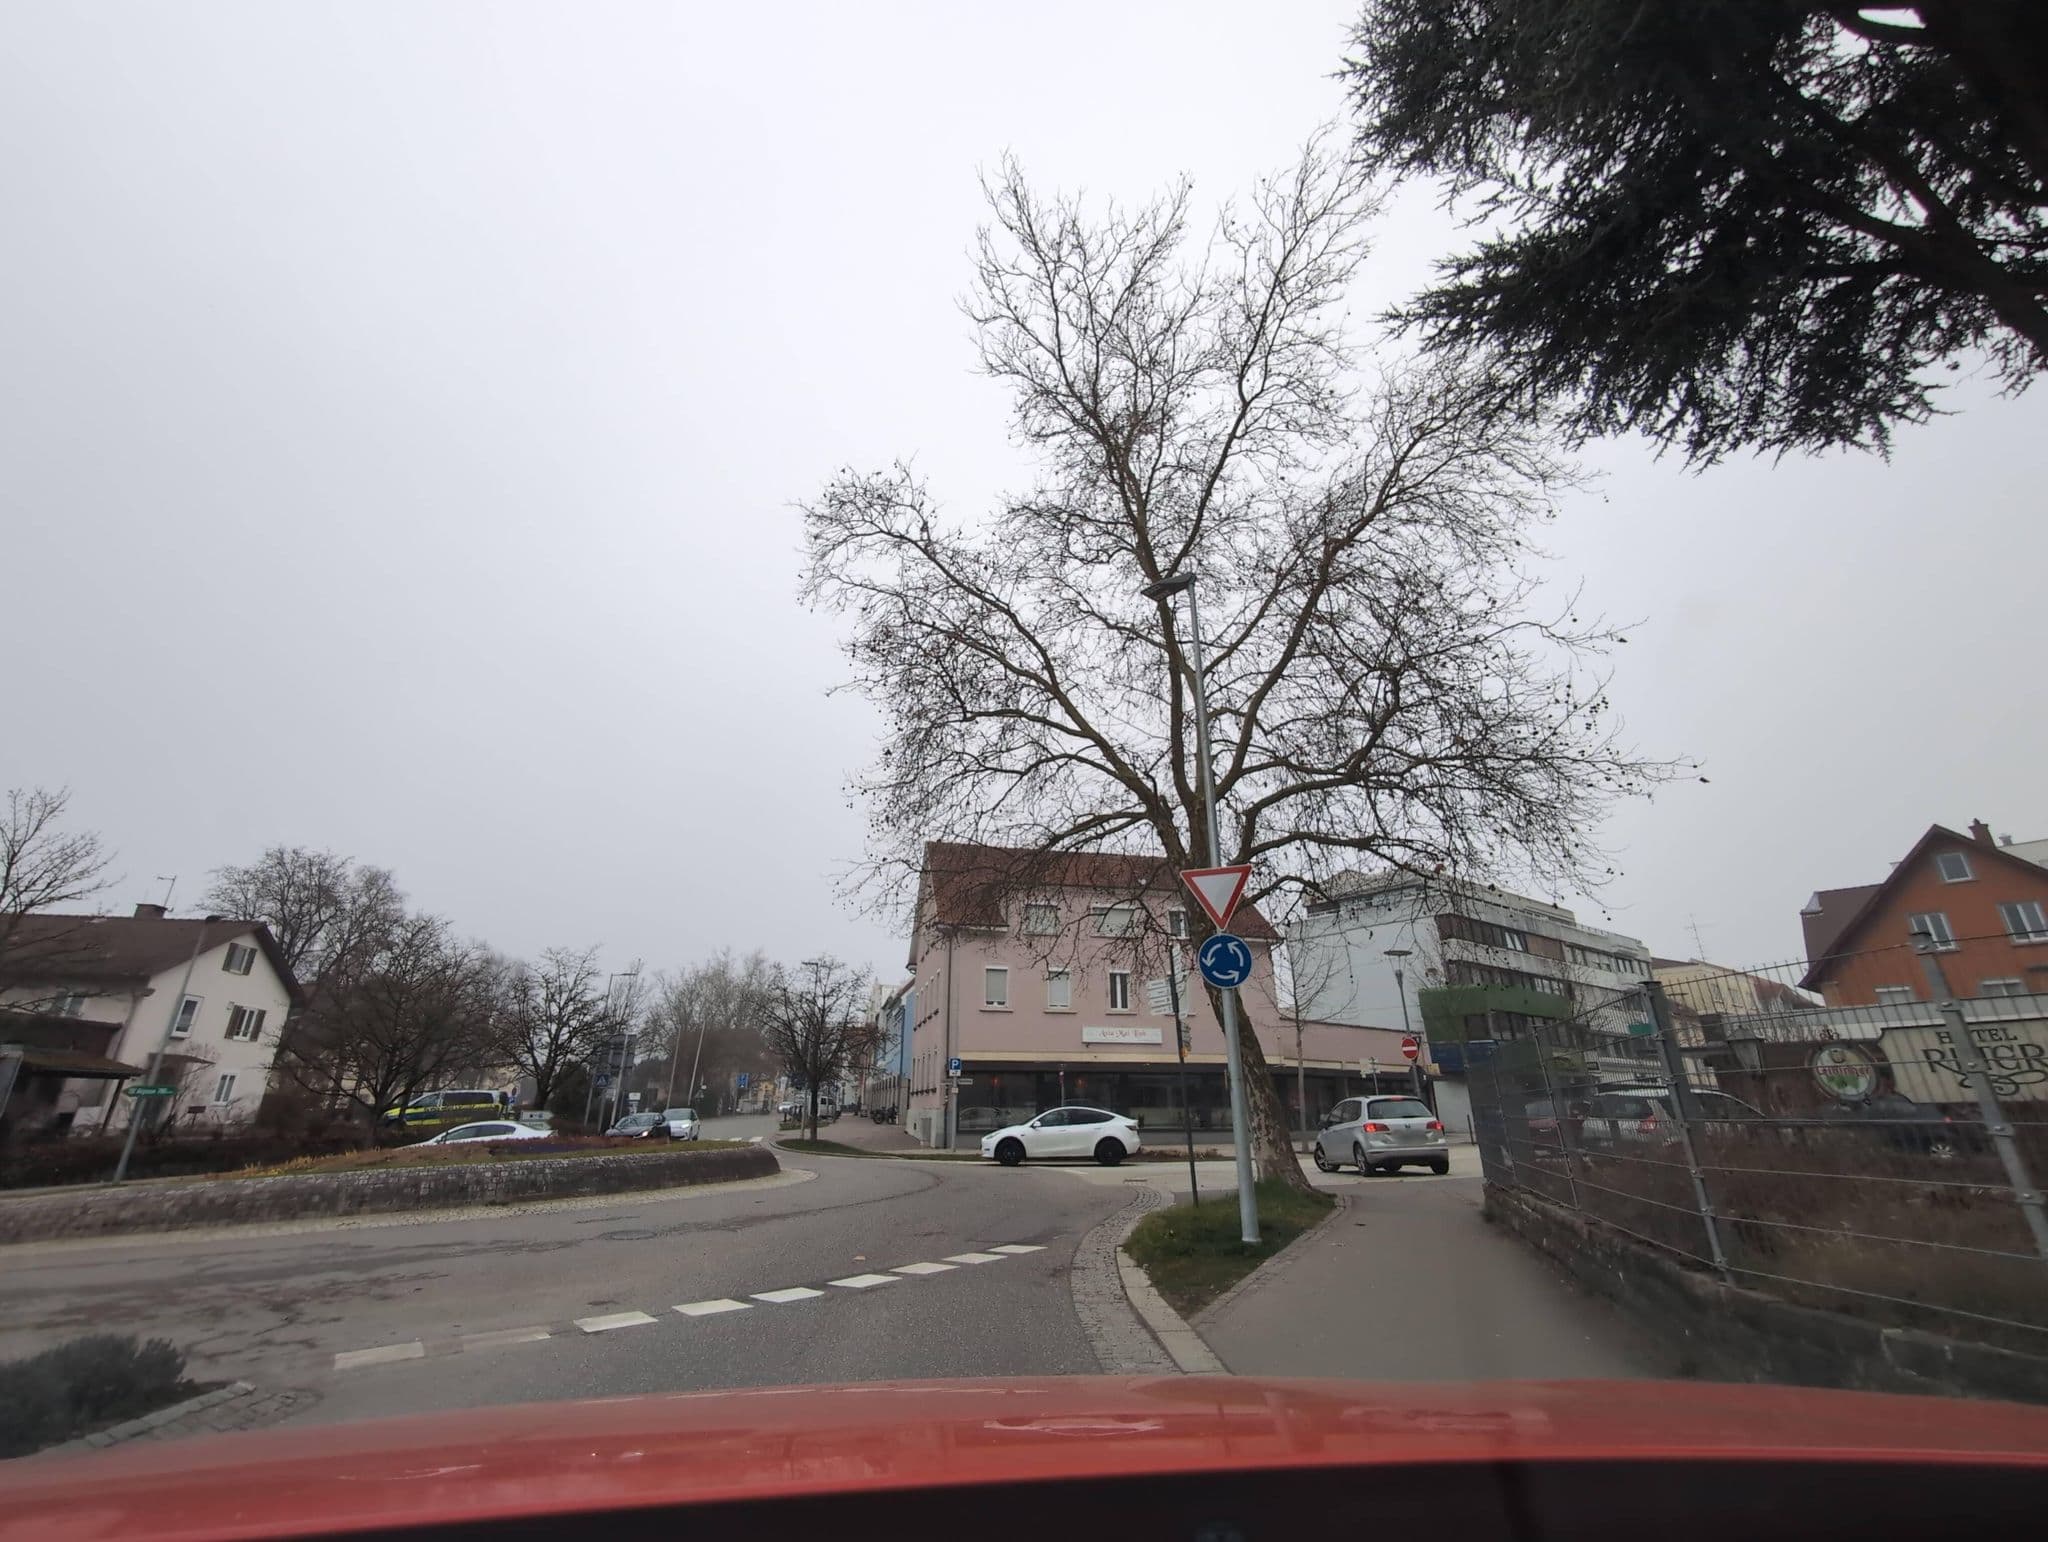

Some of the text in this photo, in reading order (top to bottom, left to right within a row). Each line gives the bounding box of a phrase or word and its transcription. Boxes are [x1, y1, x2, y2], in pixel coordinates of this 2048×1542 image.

[1936, 1027, 2018, 1044] HTEL
[951, 1059, 959, 1070] P
[1920, 1043, 2048, 1075] RITER
